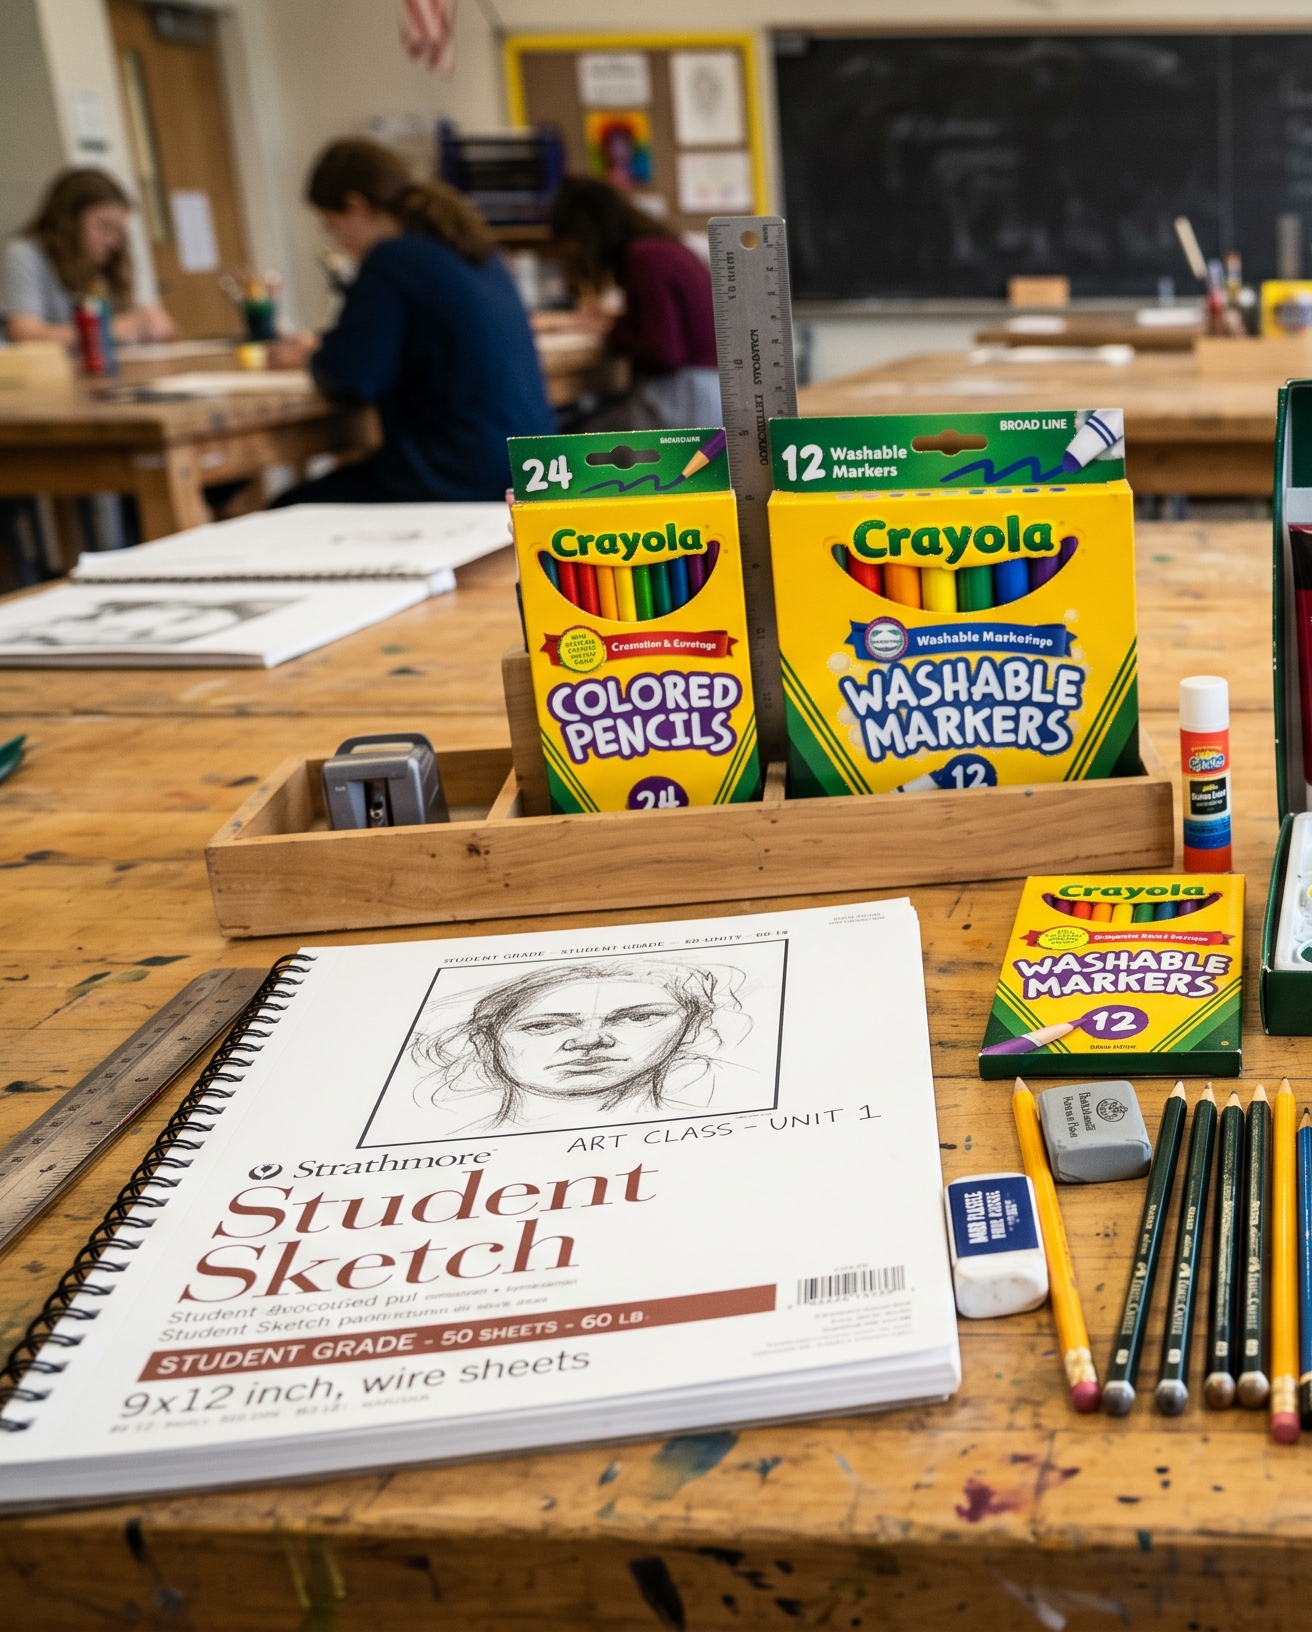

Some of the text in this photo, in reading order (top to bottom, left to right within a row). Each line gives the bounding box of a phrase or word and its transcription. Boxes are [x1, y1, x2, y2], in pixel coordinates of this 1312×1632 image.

[1000, 419, 1067, 431] BROAD LINE
[782, 444, 826, 482] 12
[830, 445, 907, 461] Washable
[522, 455, 573, 493] 24
[832, 462, 898, 479] Markers
[551, 523, 703, 561] Crayola
[853, 515, 1055, 564] Crayola
[663, 639, 671, 648] &
[916, 631, 980, 646] Washable
[552, 674, 738, 721] COLORED
[842, 659, 1082, 716] WASHABLE
[565, 711, 733, 760] PENCILS
[864, 705, 1070, 759] MARKERS
[951, 763, 989, 788] 12
[636, 785, 681, 810] 24
[1058, 883, 1206, 900] Crayola
[443, 953, 500, 964] STUDENT
[1017, 950, 1232, 978] WASHABLE
[1027, 972, 1219, 998] MARKERS
[1092, 1010, 1137, 1032] 12
[566, 1133, 629, 1154] ART
[643, 1122, 733, 1145] CLASS
[769, 1108, 845, 1131] UNIT
[859, 1104, 882, 1121] 1
[292, 1149, 496, 1180] Strathmore
[210, 1162, 660, 1240] Student
[176, 1217, 580, 1304] Sketch
[158, 1324, 250, 1342] Student
[255, 1315, 330, 1335] Sketch
[168, 1306, 257, 1325] Student
[155, 1344, 306, 1376] STUDENT
[312, 1332, 416, 1360] GRADE
[440, 1328, 474, 1346] 50
[478, 1319, 558, 1342] SHEETS
[580, 1312, 613, 1330] 60
[119, 1348, 592, 1419] 9x12 inch, wire sheets
